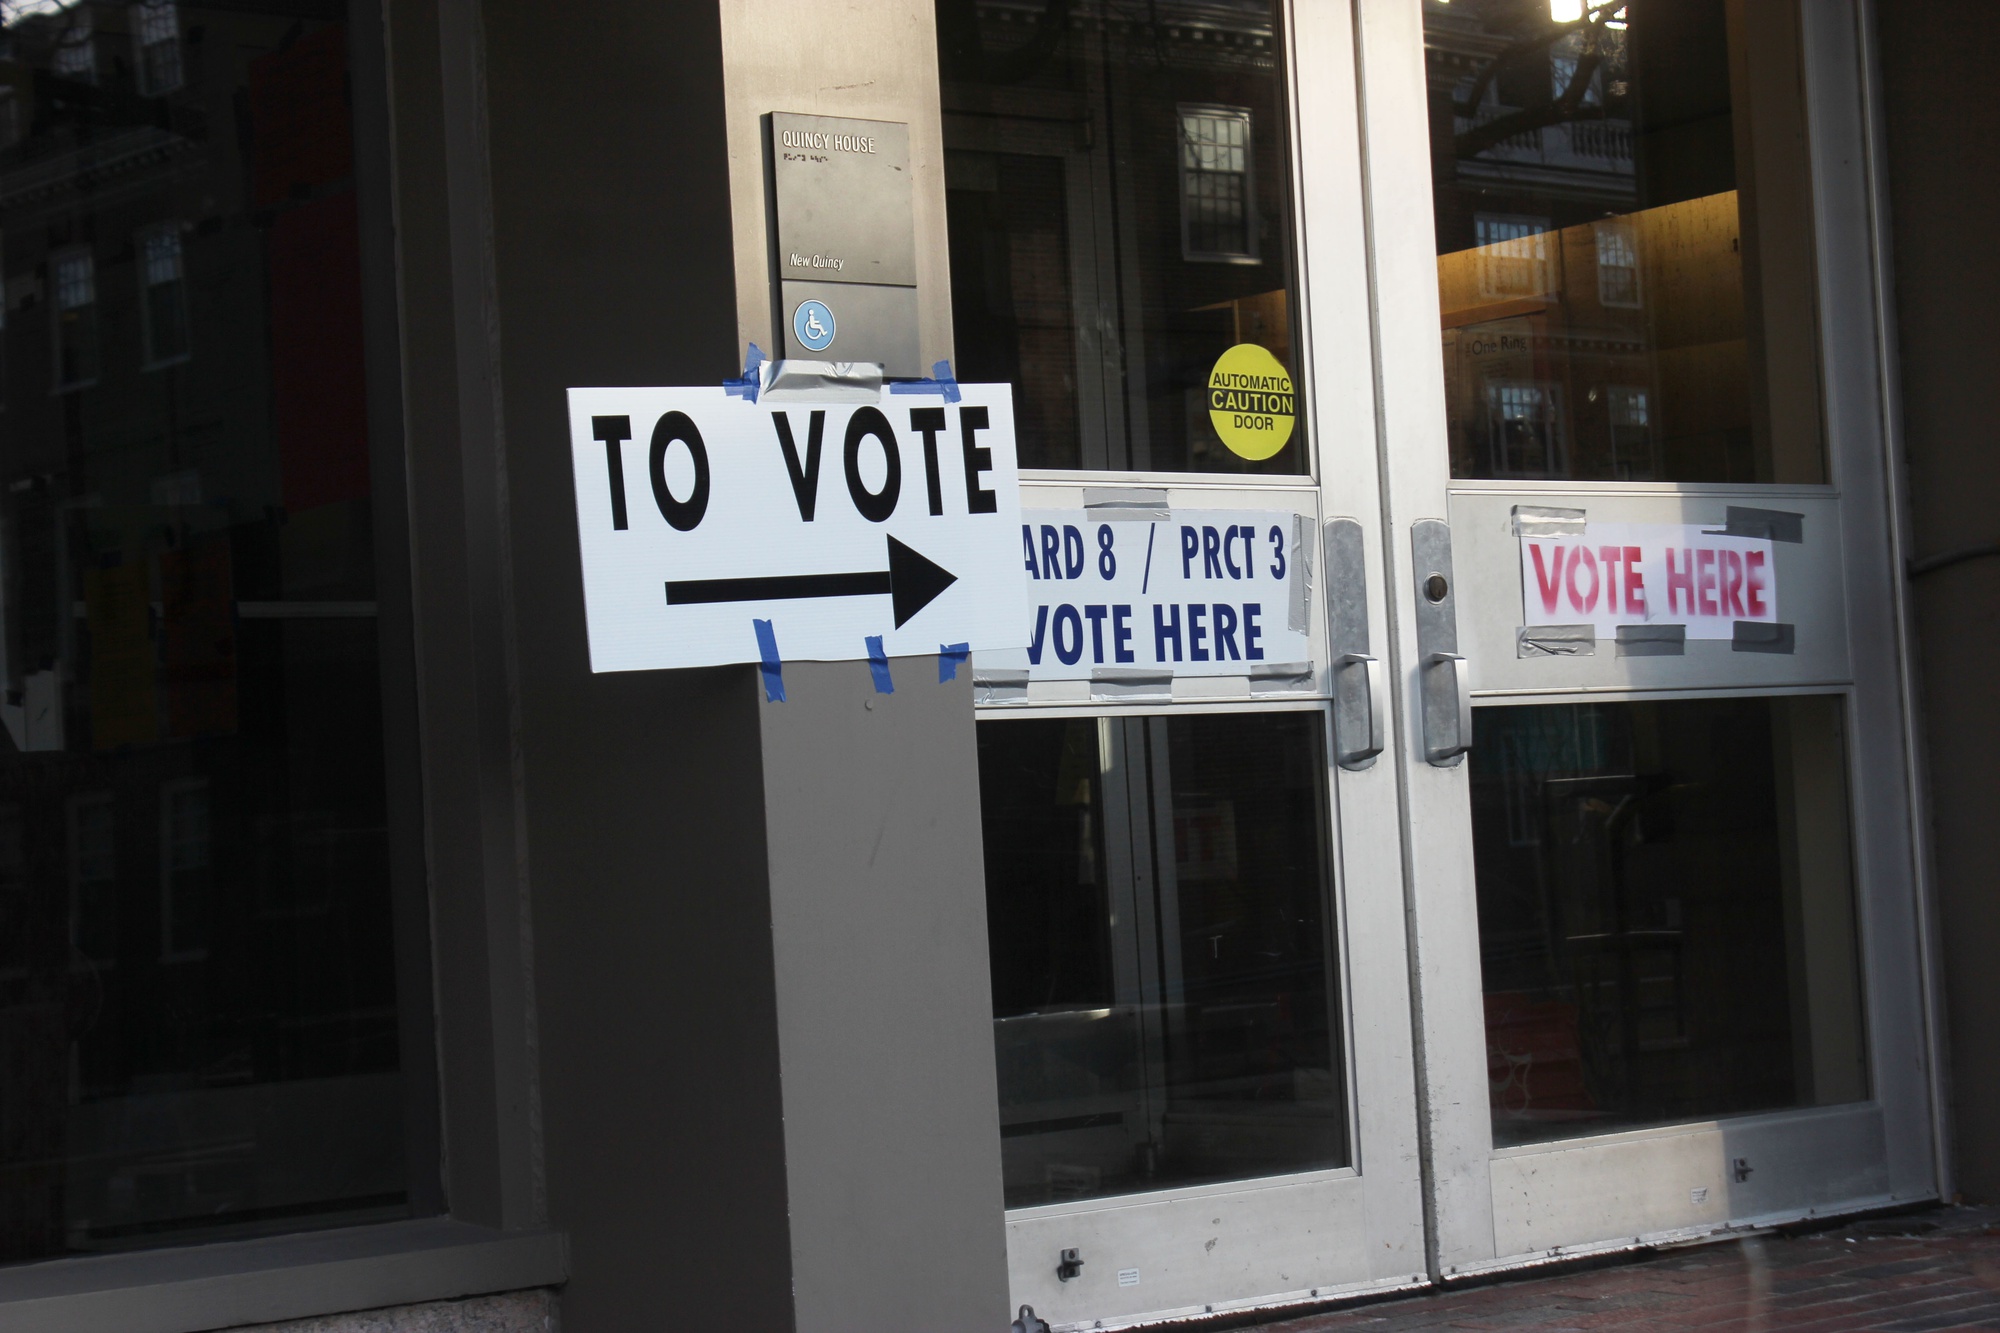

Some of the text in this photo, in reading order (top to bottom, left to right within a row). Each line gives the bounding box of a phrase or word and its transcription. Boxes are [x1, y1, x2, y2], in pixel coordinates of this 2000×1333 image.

[782, 130, 876, 154] QUINCY HOUSE
[789, 253, 844, 271] New Quincy
[1472, 340, 1498, 356] One
[1501, 335, 1527, 352] Ring
[1212, 372, 1290, 392] AUTOMATIC
[1211, 390, 1294, 414] CAUTION
[1233, 414, 1274, 431] DOOR
[591, 405, 998, 531] TO VOTE
[1022, 522, 1287, 595] ARD 8 / PRCT 3
[1528, 543, 1768, 618] VOTE HERE
[1026, 602, 1265, 666] VOTE HERE
